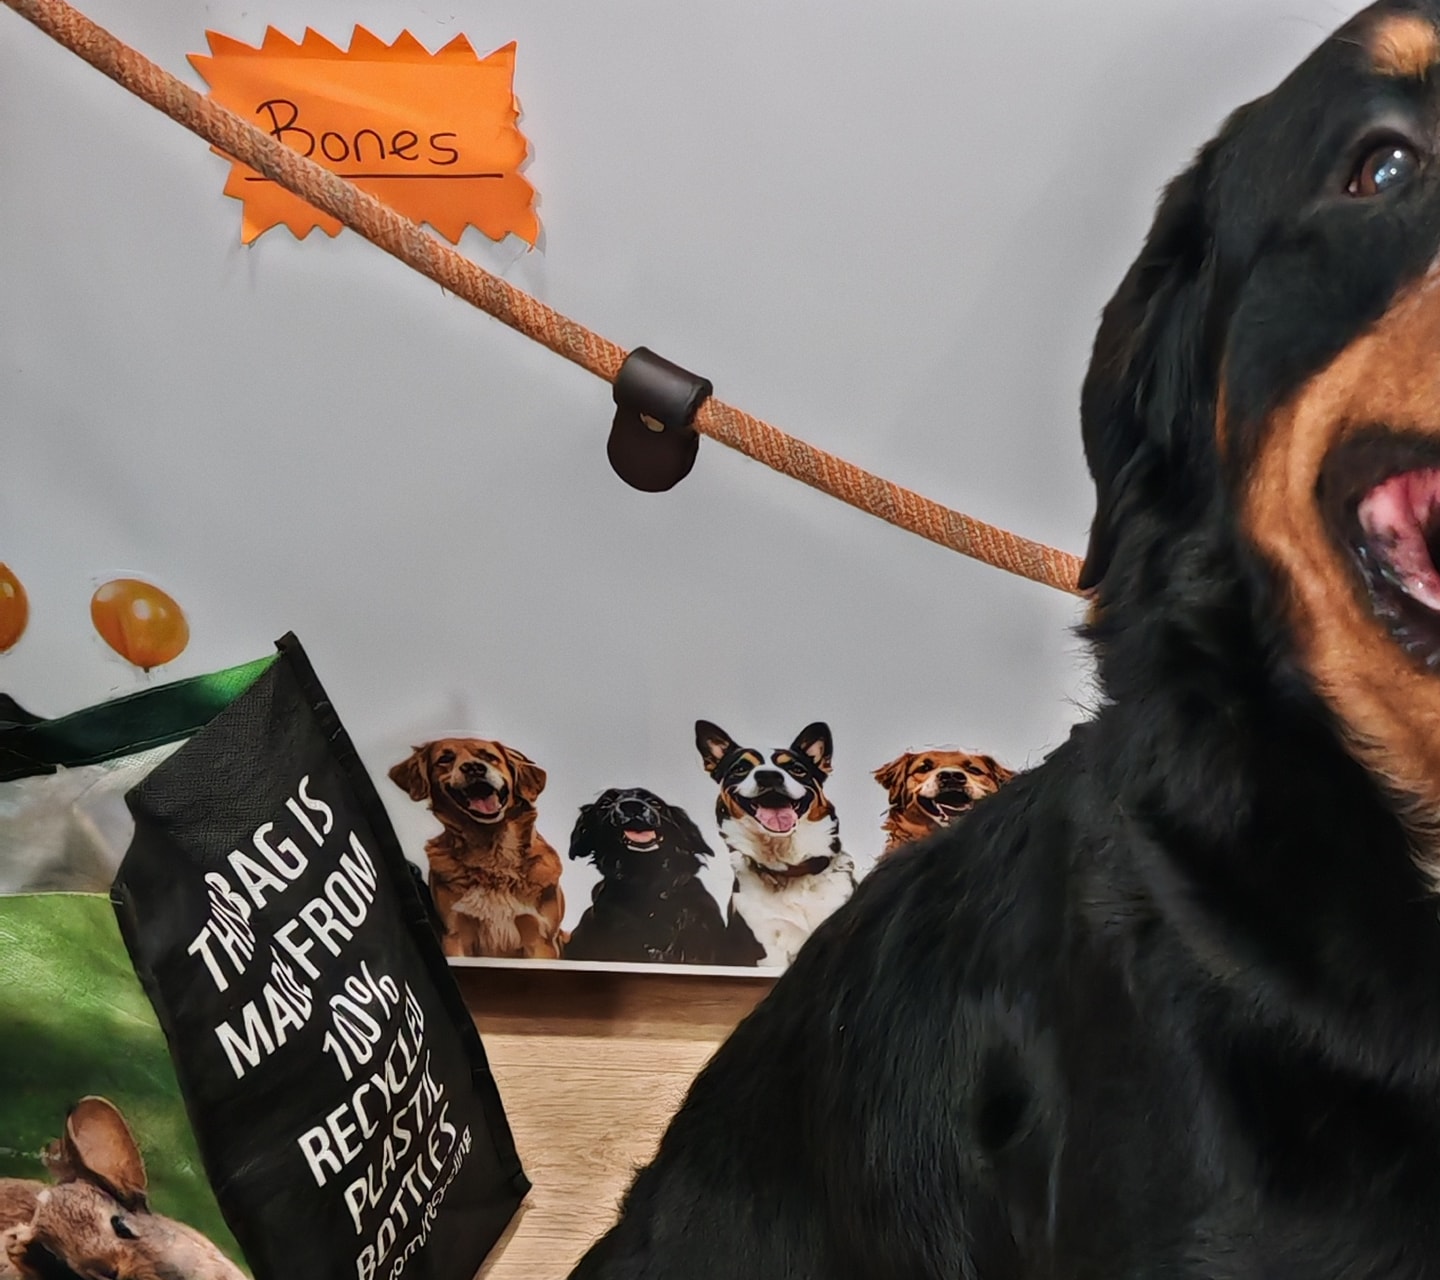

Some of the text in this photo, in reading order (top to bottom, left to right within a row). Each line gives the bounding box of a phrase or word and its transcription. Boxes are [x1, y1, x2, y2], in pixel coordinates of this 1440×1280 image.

[256, 98, 459, 166] Bones
[187, 774, 334, 993] THIS BAG IS
[214, 830, 377, 1080] MADE FROM
[297, 979, 425, 1189] RECYCLED
[322, 960, 400, 1082] 100%
[344, 1048, 444, 1236] PLASTIC
